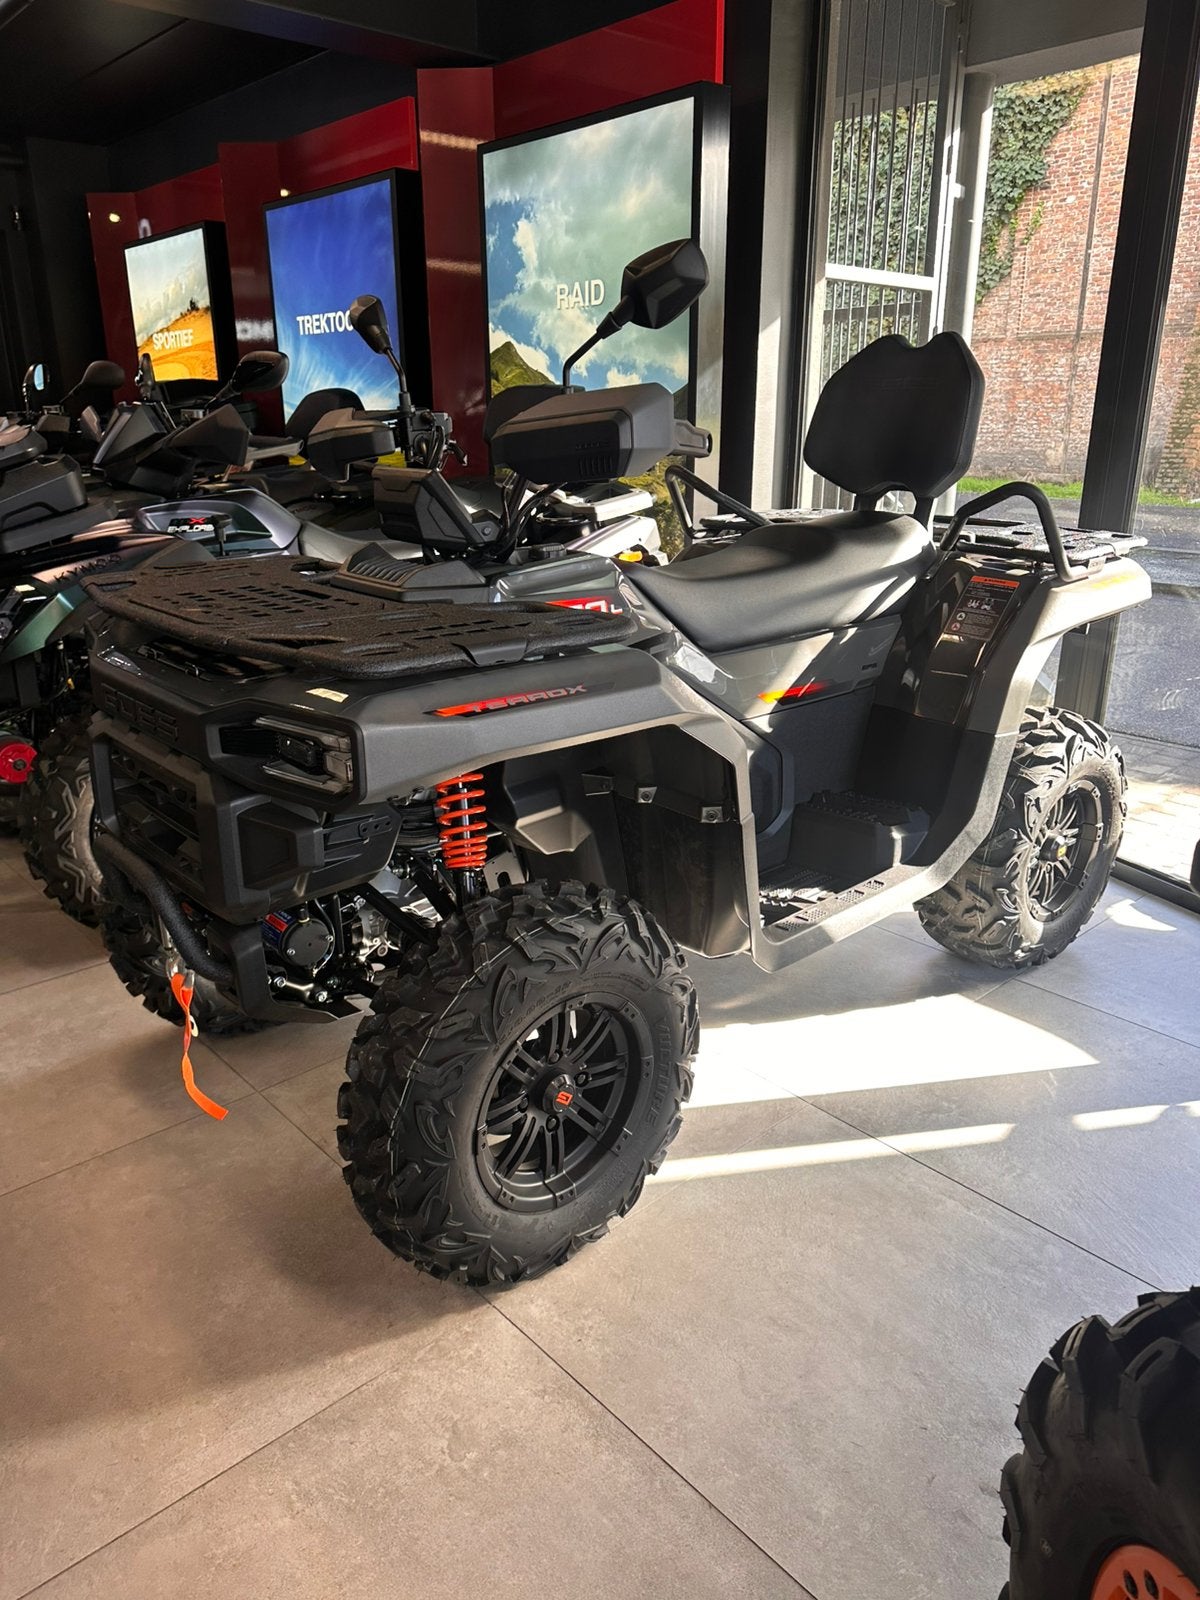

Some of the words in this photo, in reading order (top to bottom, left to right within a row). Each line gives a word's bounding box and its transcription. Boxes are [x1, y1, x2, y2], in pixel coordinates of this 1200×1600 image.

[556, 279, 605, 310] RAID
[296, 310, 354, 336] TREKTOC
[152, 328, 194, 351] SPORTIEF
[471, 684, 588, 713] TERROX
